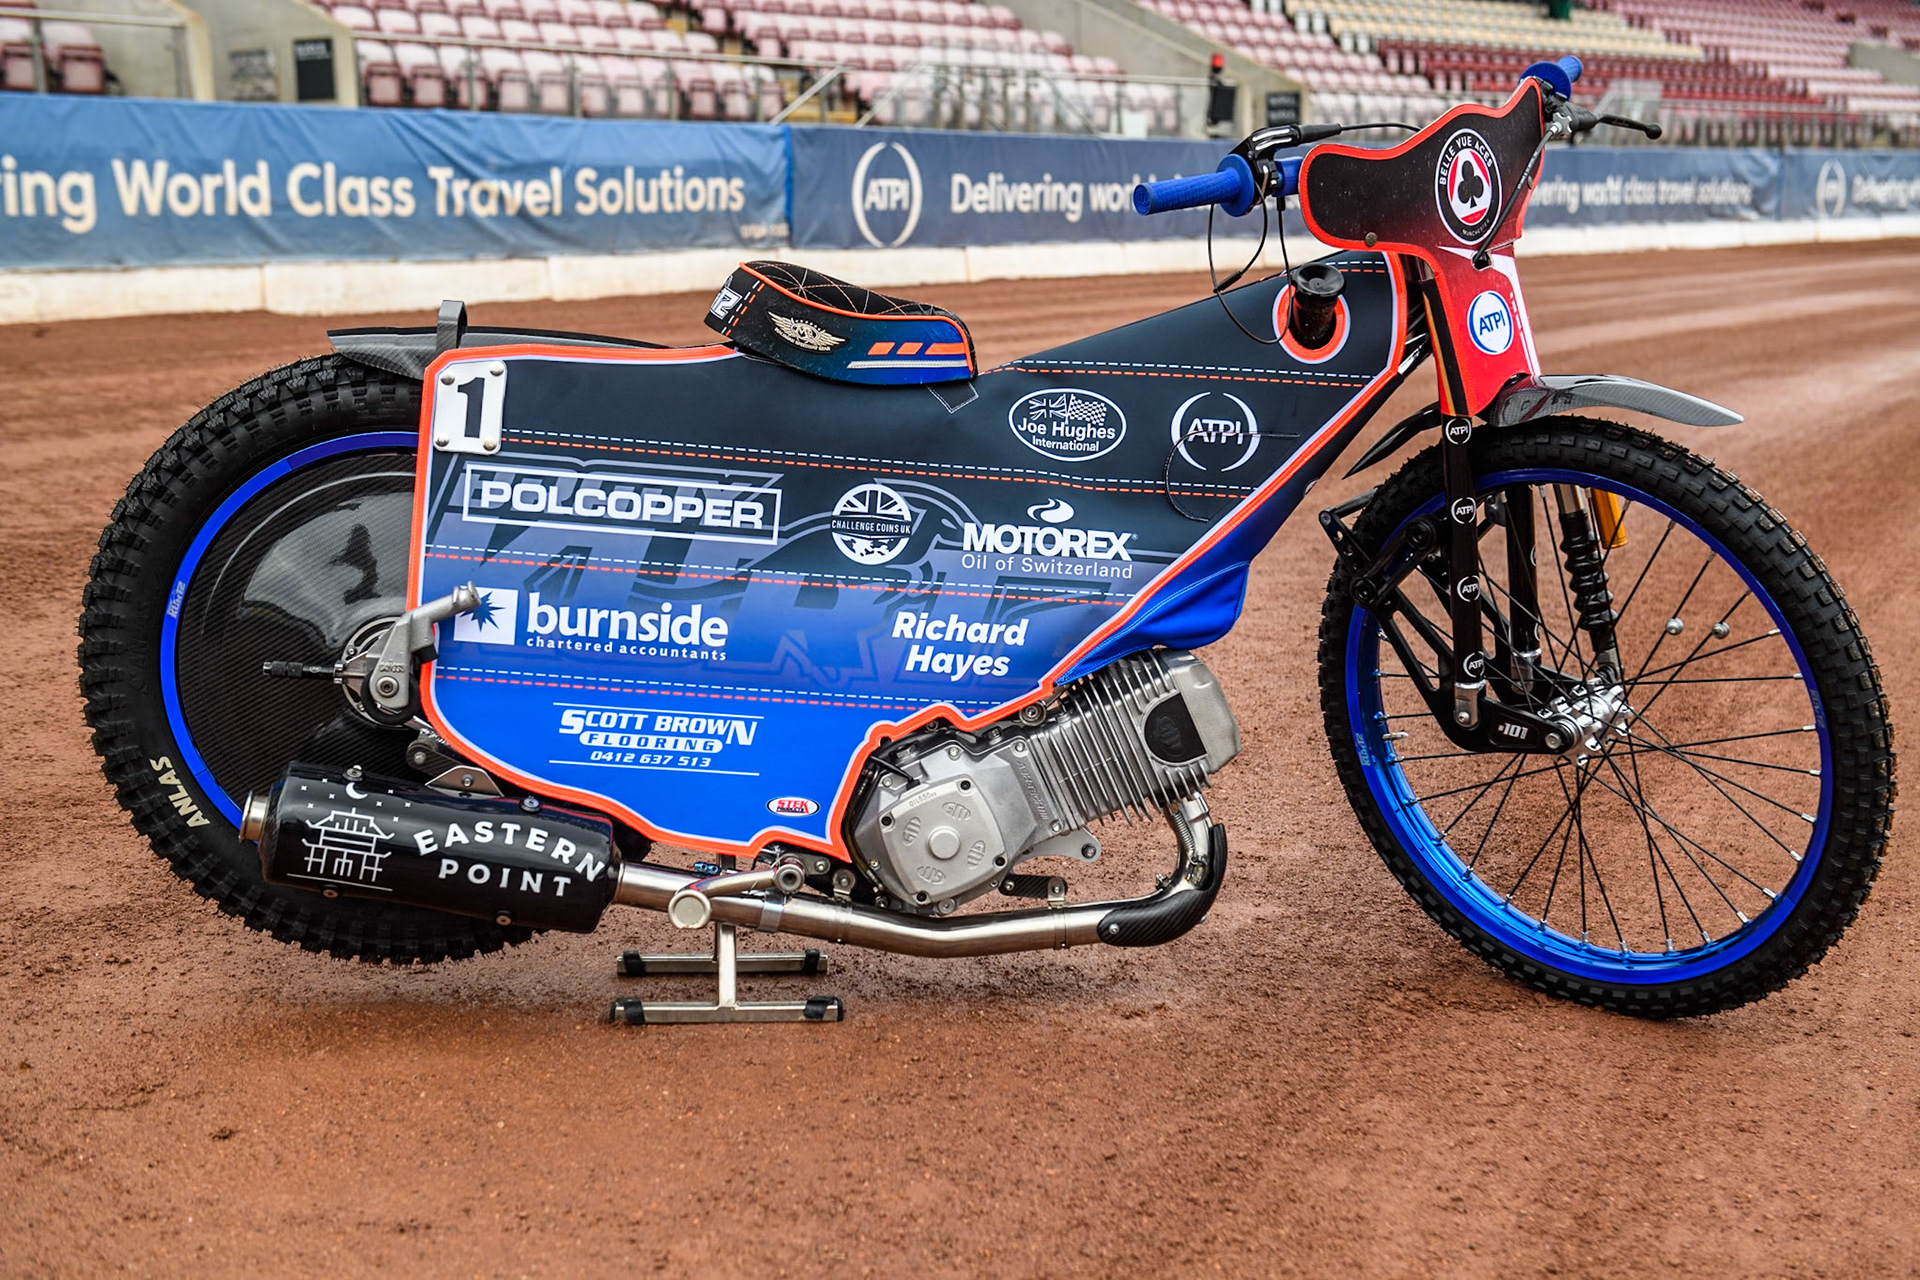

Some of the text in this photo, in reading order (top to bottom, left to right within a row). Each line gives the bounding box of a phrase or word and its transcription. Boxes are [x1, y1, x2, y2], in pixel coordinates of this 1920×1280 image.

[1439, 136, 1493, 185] BELLE VUE ACES
[0, 154, 745, 234] ing World Class Travel Solutions
[864, 178, 909, 211] ATPI
[951, 172, 1083, 223] Delivering
[1478, 310, 1506, 336] ATPI
[457, 377, 485, 438] 1
[1017, 418, 1116, 441] Joe Hughes
[1032, 435, 1099, 452] International
[1188, 418, 1243, 444] ATPI
[1450, 425, 1469, 436] ATPI
[480, 480, 766, 530] POLCOPPER
[1456, 505, 1474, 515] ATPI
[831, 519, 911, 534] CHALLENGE COINS UK
[961, 553, 1133, 579] Oil of Switzerland
[527, 592, 728, 647] burnside
[892, 611, 1028, 647] Richard
[526, 636, 727, 661] chartered accountants
[905, 643, 1010, 681] Hayes
[559, 709, 757, 745] SCOTT BROWN
[588, 733, 716, 751] FLOORING
[590, 751, 711, 767] 0412 637 513
[149, 756, 211, 827] ANLAS
[777, 799, 809, 815] STEK
[413, 820, 605, 882] EASTERN
[438, 859, 571, 897] POINT
